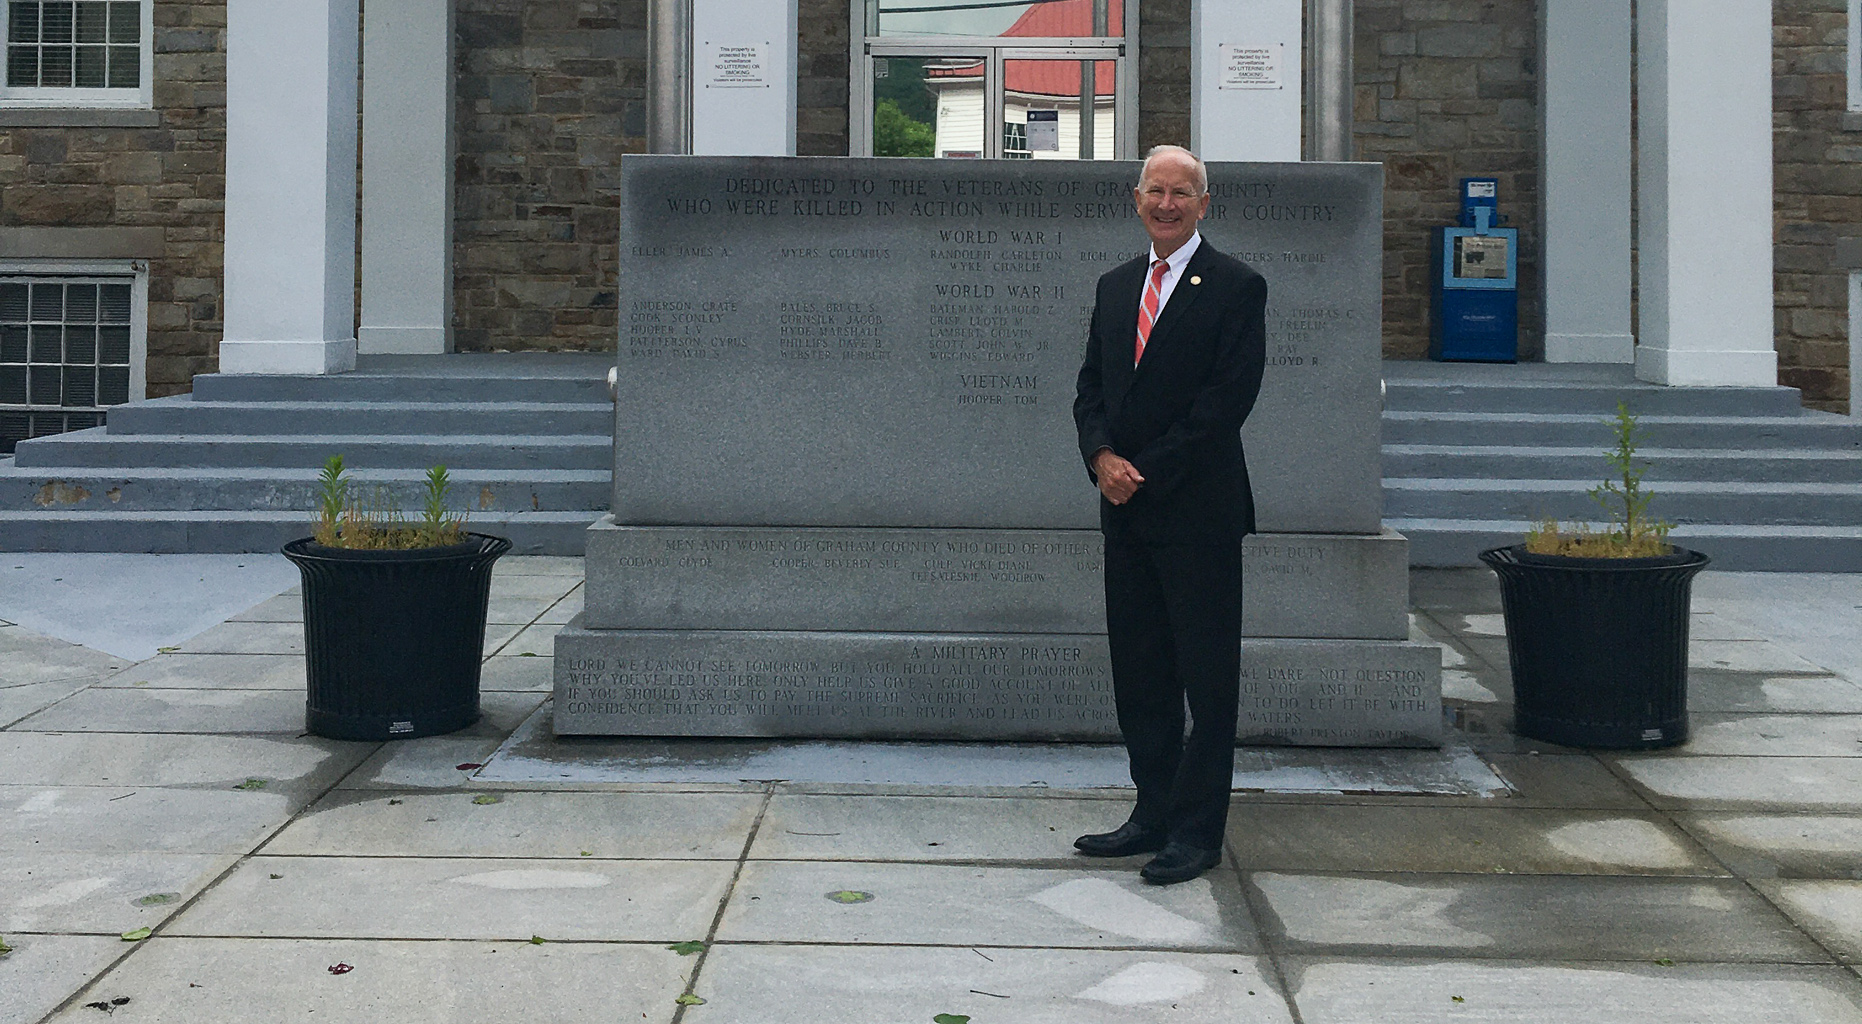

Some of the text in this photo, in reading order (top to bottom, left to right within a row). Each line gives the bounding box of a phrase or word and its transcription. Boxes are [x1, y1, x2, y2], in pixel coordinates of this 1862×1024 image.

[726, 178, 1276, 199] DEDICATED TO THE VETERANS OF OUNTY
[667, 198, 712, 215] WHO
[726, 199, 779, 216] WERE
[793, 200, 862, 216] KILLED
[876, 201, 895, 216] IN
[910, 201, 983, 218] ACTION
[998, 202, 1060, 218] WHILE
[1242, 204, 1336, 221] COUNTRY
[939, 230, 1062, 245] WORLD WAR I
[829, 248, 891, 259] COLUMBUS
[1001, 250, 1062, 261] CARLETON
[1283, 253, 1327, 263] HARDIE
[993, 262, 1042, 273] CHARLIE
[935, 284, 1065, 299] WORLD WAR II
[701, 302, 738, 312] CRATE
[994, 305, 1040, 315] HAROLD
[1290, 308, 1340, 319] THOMAS
[846, 315, 883, 325] JACOB
[970, 317, 1008, 326] LLOYD
[710, 337, 747, 348] CYRUS
[975, 340, 1005, 350] JOHN
[987, 352, 1035, 362] EDWARD
[960, 374, 1038, 390] VIETNAM
[1014, 395, 1038, 405] TOM
[665, 539, 1326, 559] MEN AND WOMEN OF GRAHAM COUNTY WHO DIED OF OTHER DUTY
[910, 646, 1081, 662] A MILITARY PRAYER
[569, 658, 606, 671] LORD
[616, 659, 638, 671] WE
[645, 659, 702, 672] CANNOT
[711, 660, 734, 672] SEE
[746, 660, 819, 673] TOMORROW
[831, 661, 857, 674] BUT
[866, 662, 895, 674] YOU
[902, 662, 940, 675] HOLD
[949, 664, 976, 676] ALL
[982, 664, 1010, 676] OUR
[1020, 664, 1105, 677] TOMORROWS
[1268, 668, 1303, 681] DARE
[1319, 669, 1348, 681] NOT
[1355, 670, 1426, 682] QUESTION
[569, 673, 602, 686] WHY
[669, 674, 695, 686] LED
[702, 674, 720, 687] US
[773, 675, 809, 688] ONLY
[817, 676, 852, 688] HELP
[859, 676, 876, 689] US
[883, 677, 915, 689] GIVE
[926, 677, 933, 689] A
[941, 677, 980, 690] GOOD
[990, 678, 1052, 691] ACCOUNT
[1061, 679, 1077, 691] OF
[1244, 682, 1260, 694] OF
[1317, 683, 1346, 695] AND
[1392, 684, 1421, 697] AND
[568, 687, 1426, 712] IF YOU SHOULD ASK US TO PAY THE SUPREME AS YOU WERE TO DO LET IT BE WITH
[568, 702, 655, 715] CONFIDENCE
[663, 703, 700, 715] THAT
[708, 703, 738, 715] YOU
[745, 704, 779, 716] WILL
[916, 706, 956, 718] RIVER
[966, 707, 995, 719] AND
[1003, 708, 1040, 719] LEAD
[1047, 708, 1065, 719] US
